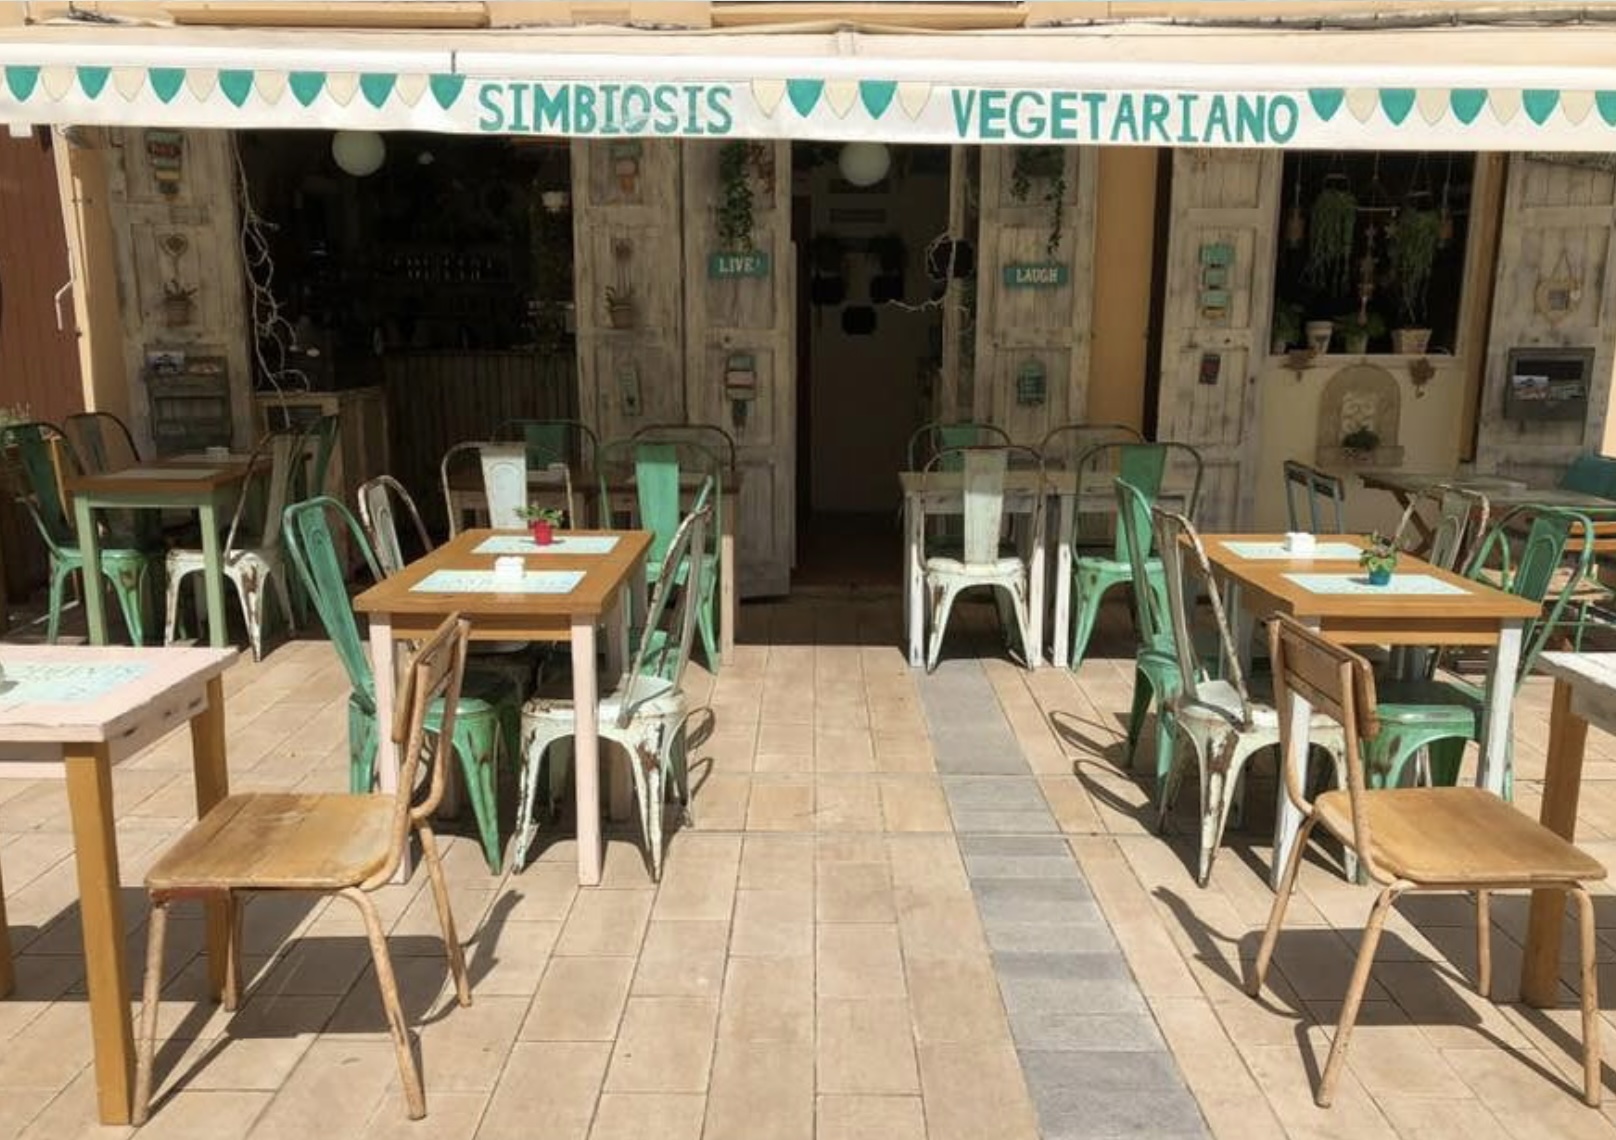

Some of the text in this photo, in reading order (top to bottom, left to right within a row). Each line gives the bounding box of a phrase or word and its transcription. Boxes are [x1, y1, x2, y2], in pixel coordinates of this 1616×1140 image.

[479, 83, 732, 134] SIMBIOSIS
[951, 89, 1299, 144] VEGETARIANO
[1016, 268, 1058, 283] LAUGH
